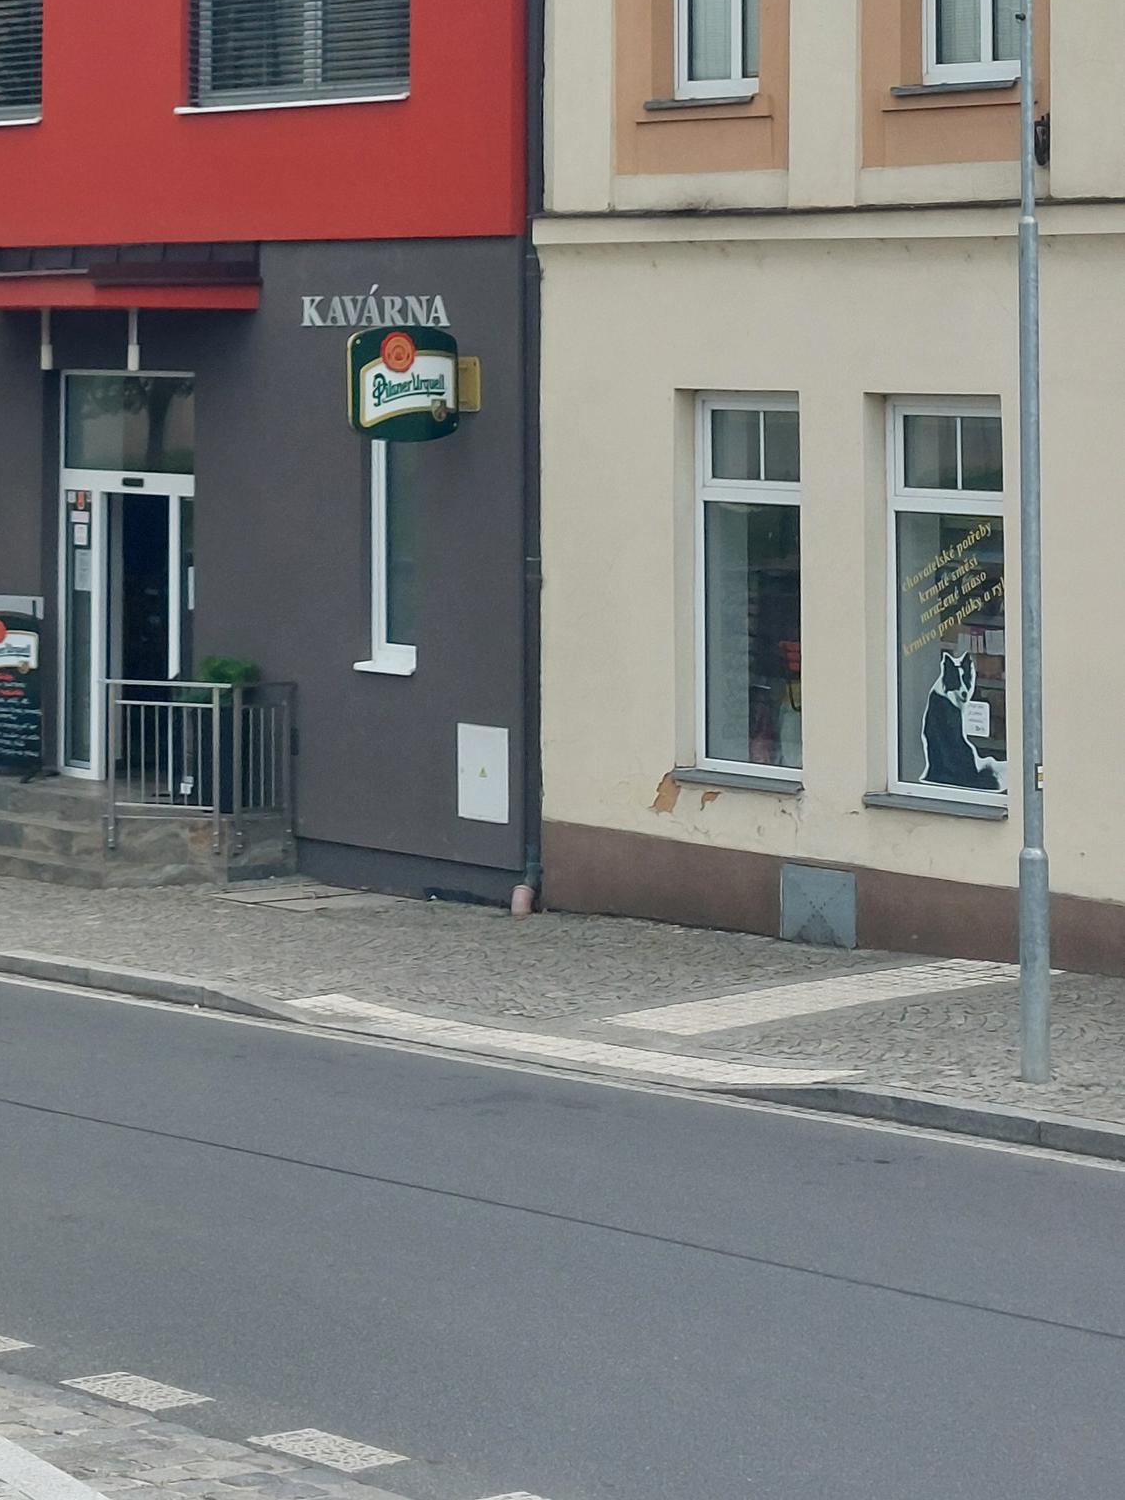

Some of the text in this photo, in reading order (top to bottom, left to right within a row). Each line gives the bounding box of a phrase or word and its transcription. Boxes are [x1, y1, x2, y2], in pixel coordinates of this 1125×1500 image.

[300, 283, 451, 327] KAVÁRNA
[372, 371, 446, 407] Pilsner Urquell
[901, 521, 993, 593] chovatelské potřeby
[960, 571, 987, 596] maso
[903, 629, 937, 658] krmivo
[937, 615, 955, 638] pro
[955, 596, 983, 626] ptáky
[983, 590, 991, 602] a
